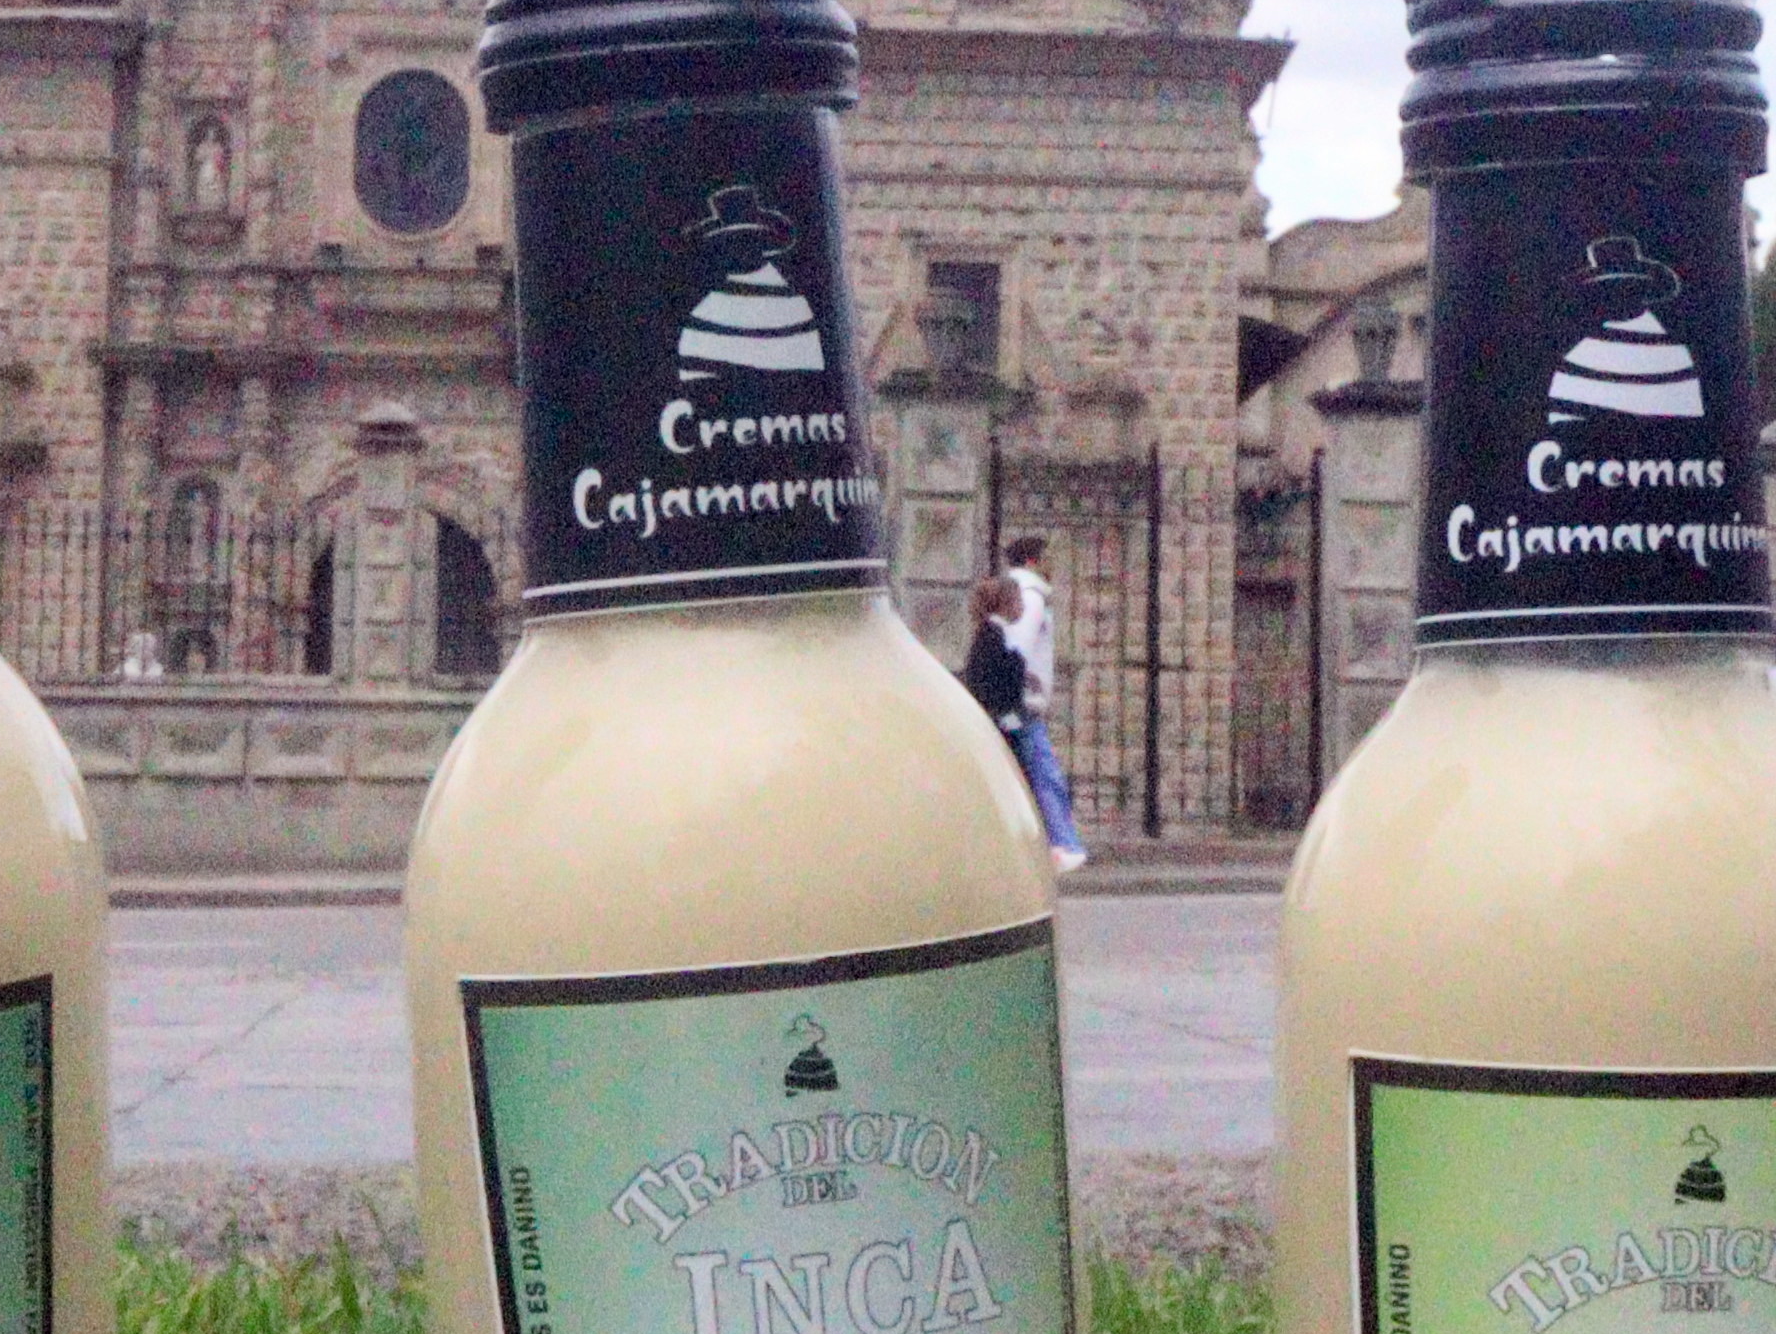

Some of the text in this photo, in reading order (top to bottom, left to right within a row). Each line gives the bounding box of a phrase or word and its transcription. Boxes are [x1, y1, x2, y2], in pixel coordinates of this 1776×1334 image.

[659, 398, 846, 455] Cremas
[1527, 439, 1724, 493] Cremas
[609, 1110, 1002, 1244] TRADICION
[780, 1170, 857, 1207] DEL
[525, 1281, 549, 1315] ES
[1661, 1280, 1731, 1313] DEL
